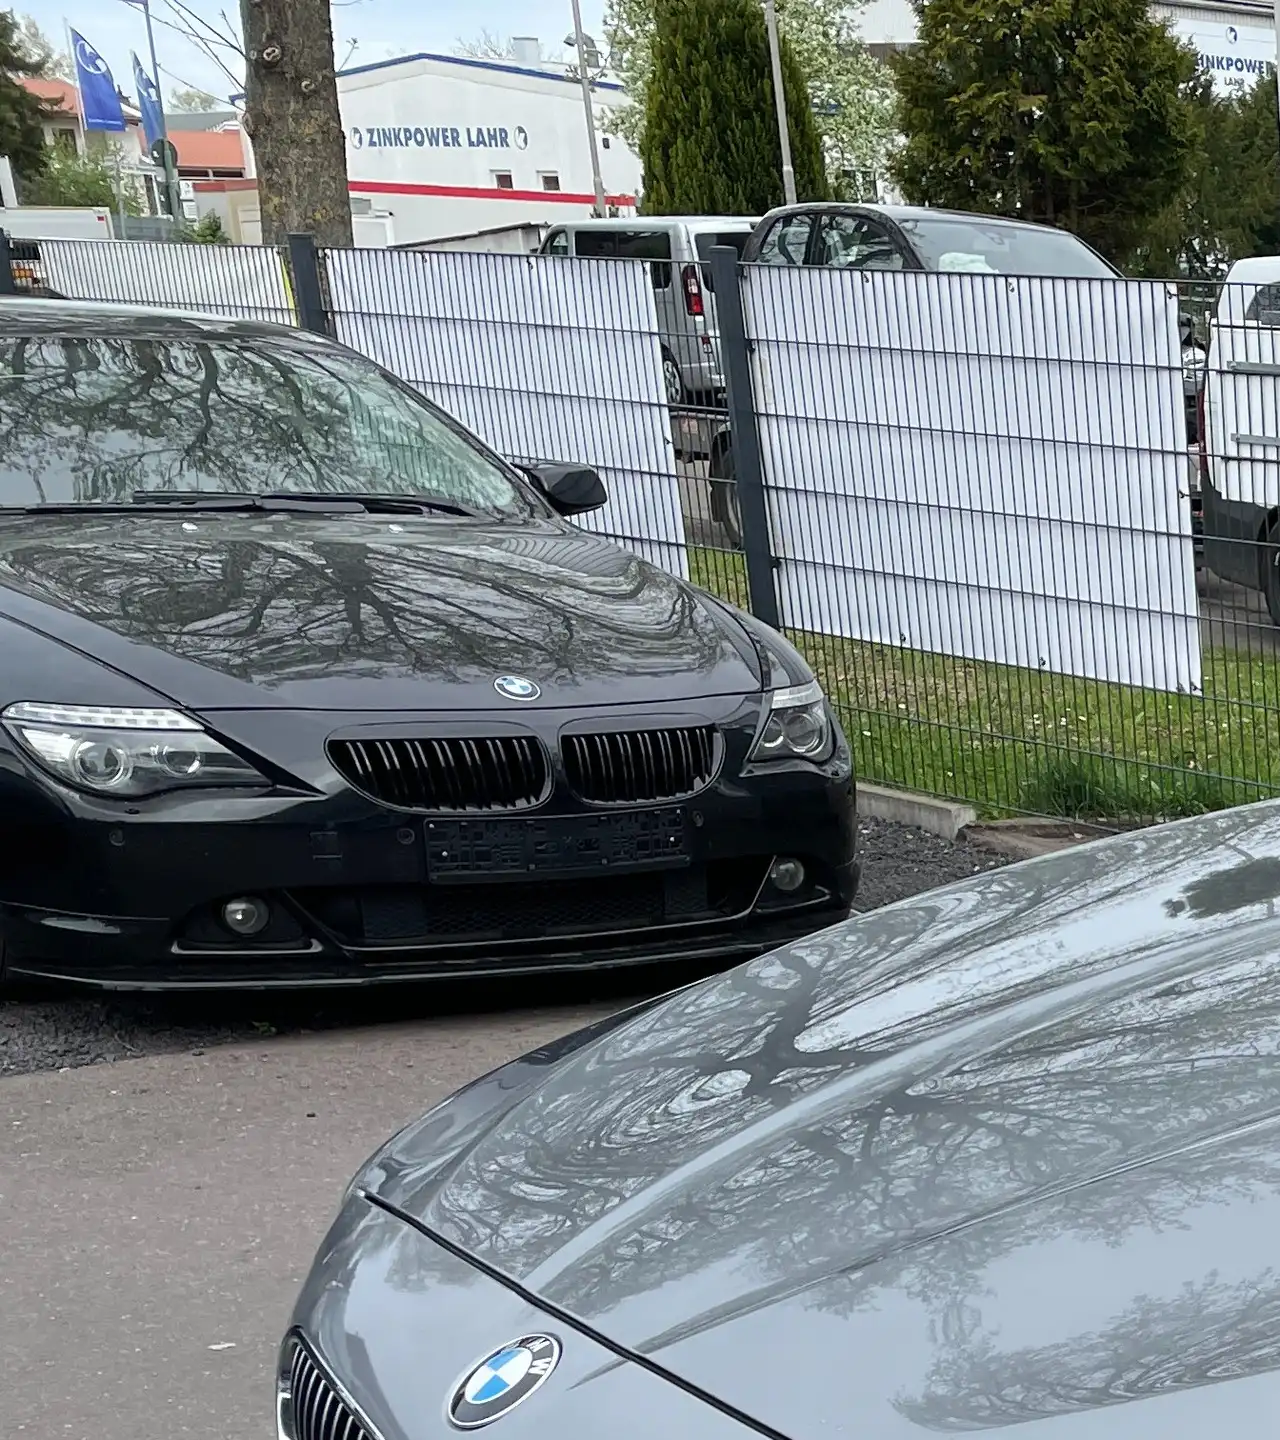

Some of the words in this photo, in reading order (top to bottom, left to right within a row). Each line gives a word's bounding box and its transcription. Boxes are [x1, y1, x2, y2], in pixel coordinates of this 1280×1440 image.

[1198, 54, 1272, 75] INKPOWE
[366, 127, 462, 148] ZINKPOWER
[466, 127, 510, 148] LAHR
